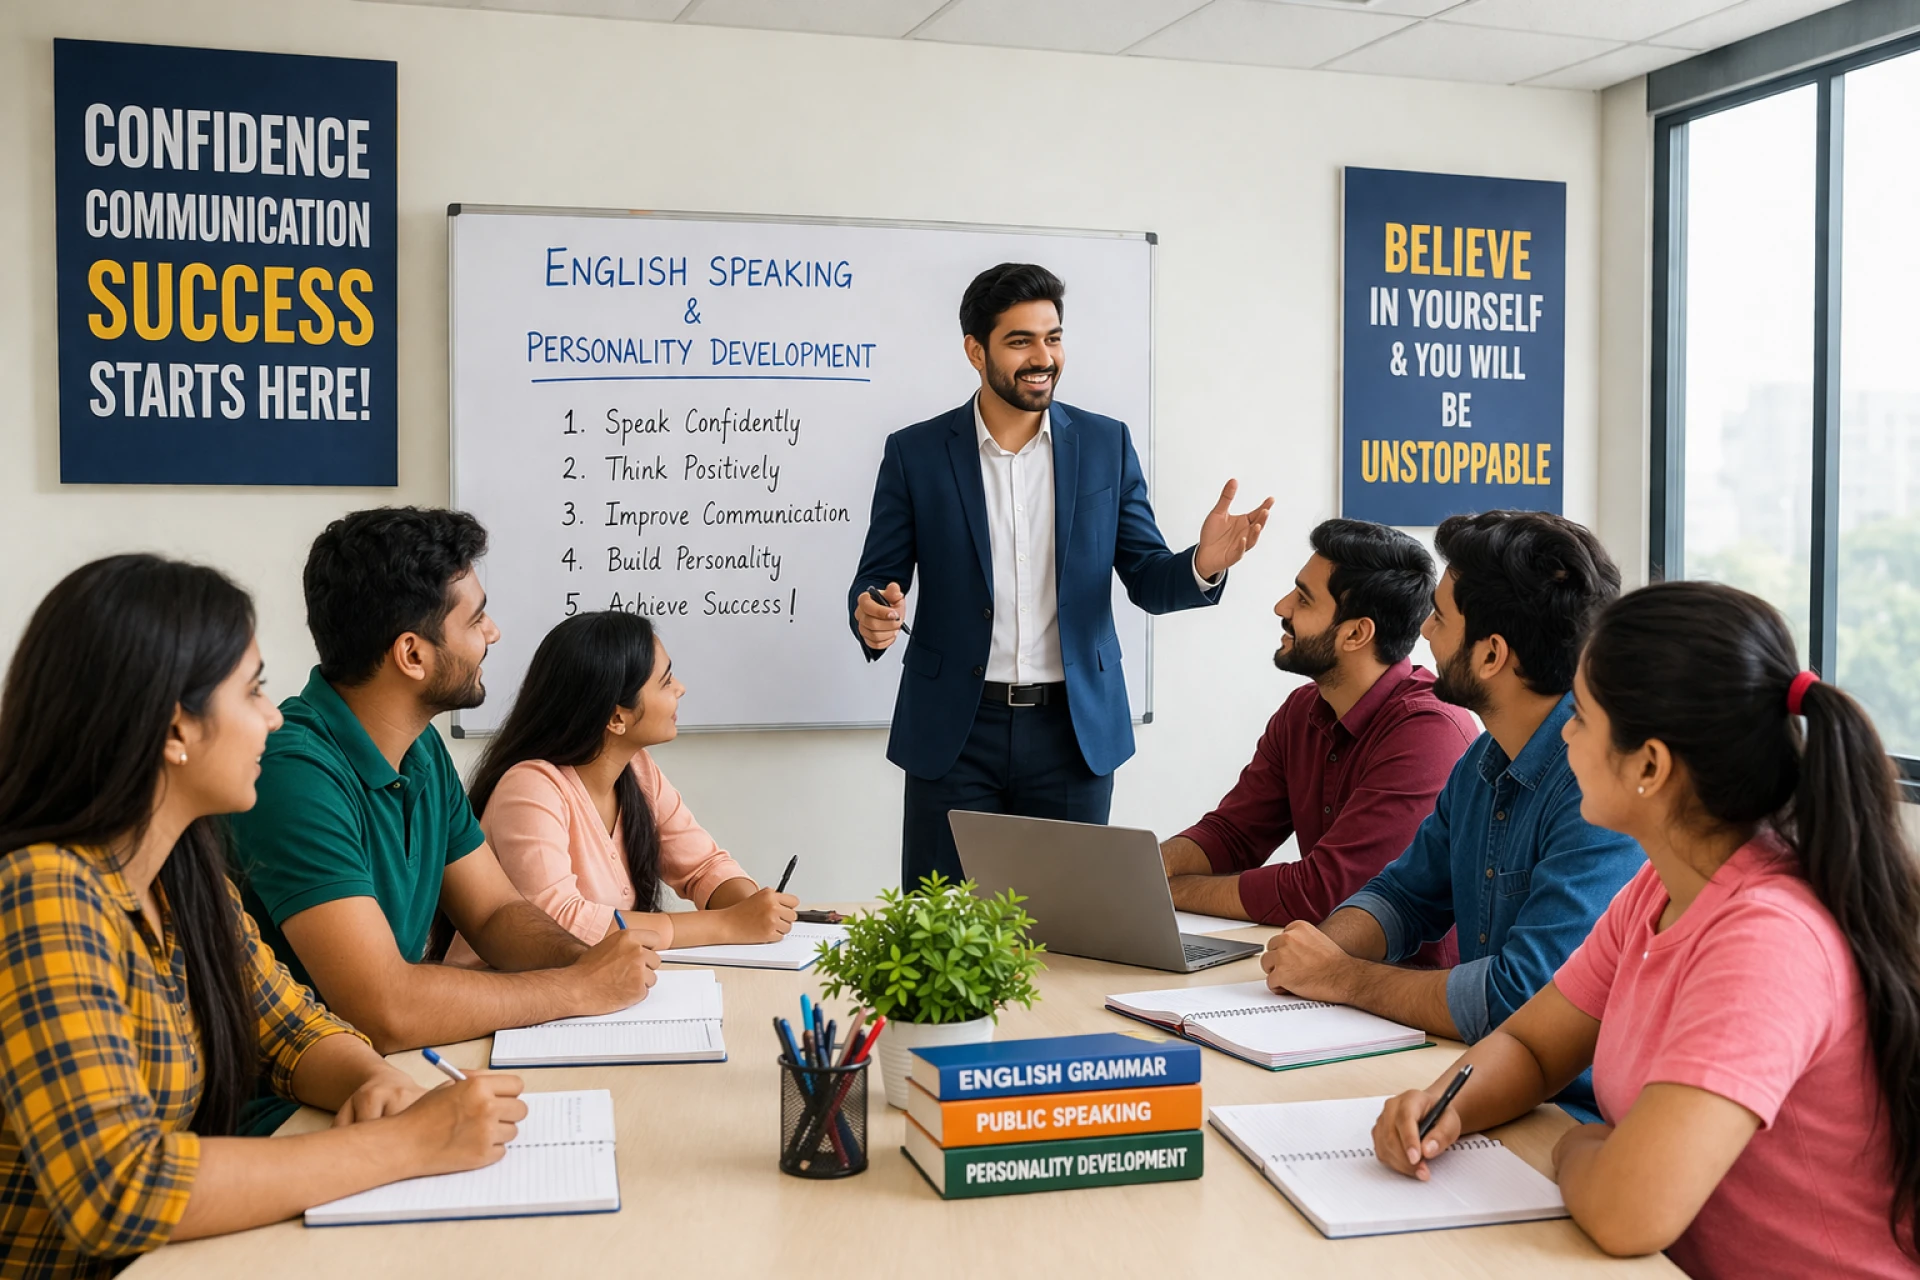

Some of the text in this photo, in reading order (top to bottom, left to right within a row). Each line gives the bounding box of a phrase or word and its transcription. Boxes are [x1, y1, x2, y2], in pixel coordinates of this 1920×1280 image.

[85, 104, 369, 179] CONFIDENCE
[86, 189, 369, 247] COMMUNICATION
[546, 247, 852, 289] ENGLISH SPEAKING
[1386, 223, 1531, 280] BELIEVE
[89, 260, 374, 346] SUCCESS
[684, 298, 701, 324] &
[1371, 287, 1543, 332] IN YOURSELF
[527, 331, 876, 368] PERSONALITY DEVELOPMENT
[1391, 342, 1525, 379] & YOU WILL
[90, 361, 370, 420] STARTS HERE!
[1443, 392, 1471, 427] BE
[564, 407, 800, 446] 1. Speak Confidently
[563, 454, 780, 493] 2. Think Positively
[1362, 440, 1550, 484] UNSTOPPABLE
[562, 500, 850, 536] 3. Improve Communication
[561, 545, 781, 581] 4. Build Personality
[609, 592, 689, 616] Achieve
[960, 1057, 1166, 1090] ENGLISH GRAMMAR
[977, 1102, 1151, 1132] PUBLIC SPEAKING
[967, 1148, 1187, 1183] PERSONALITY DEVELOPMENT
